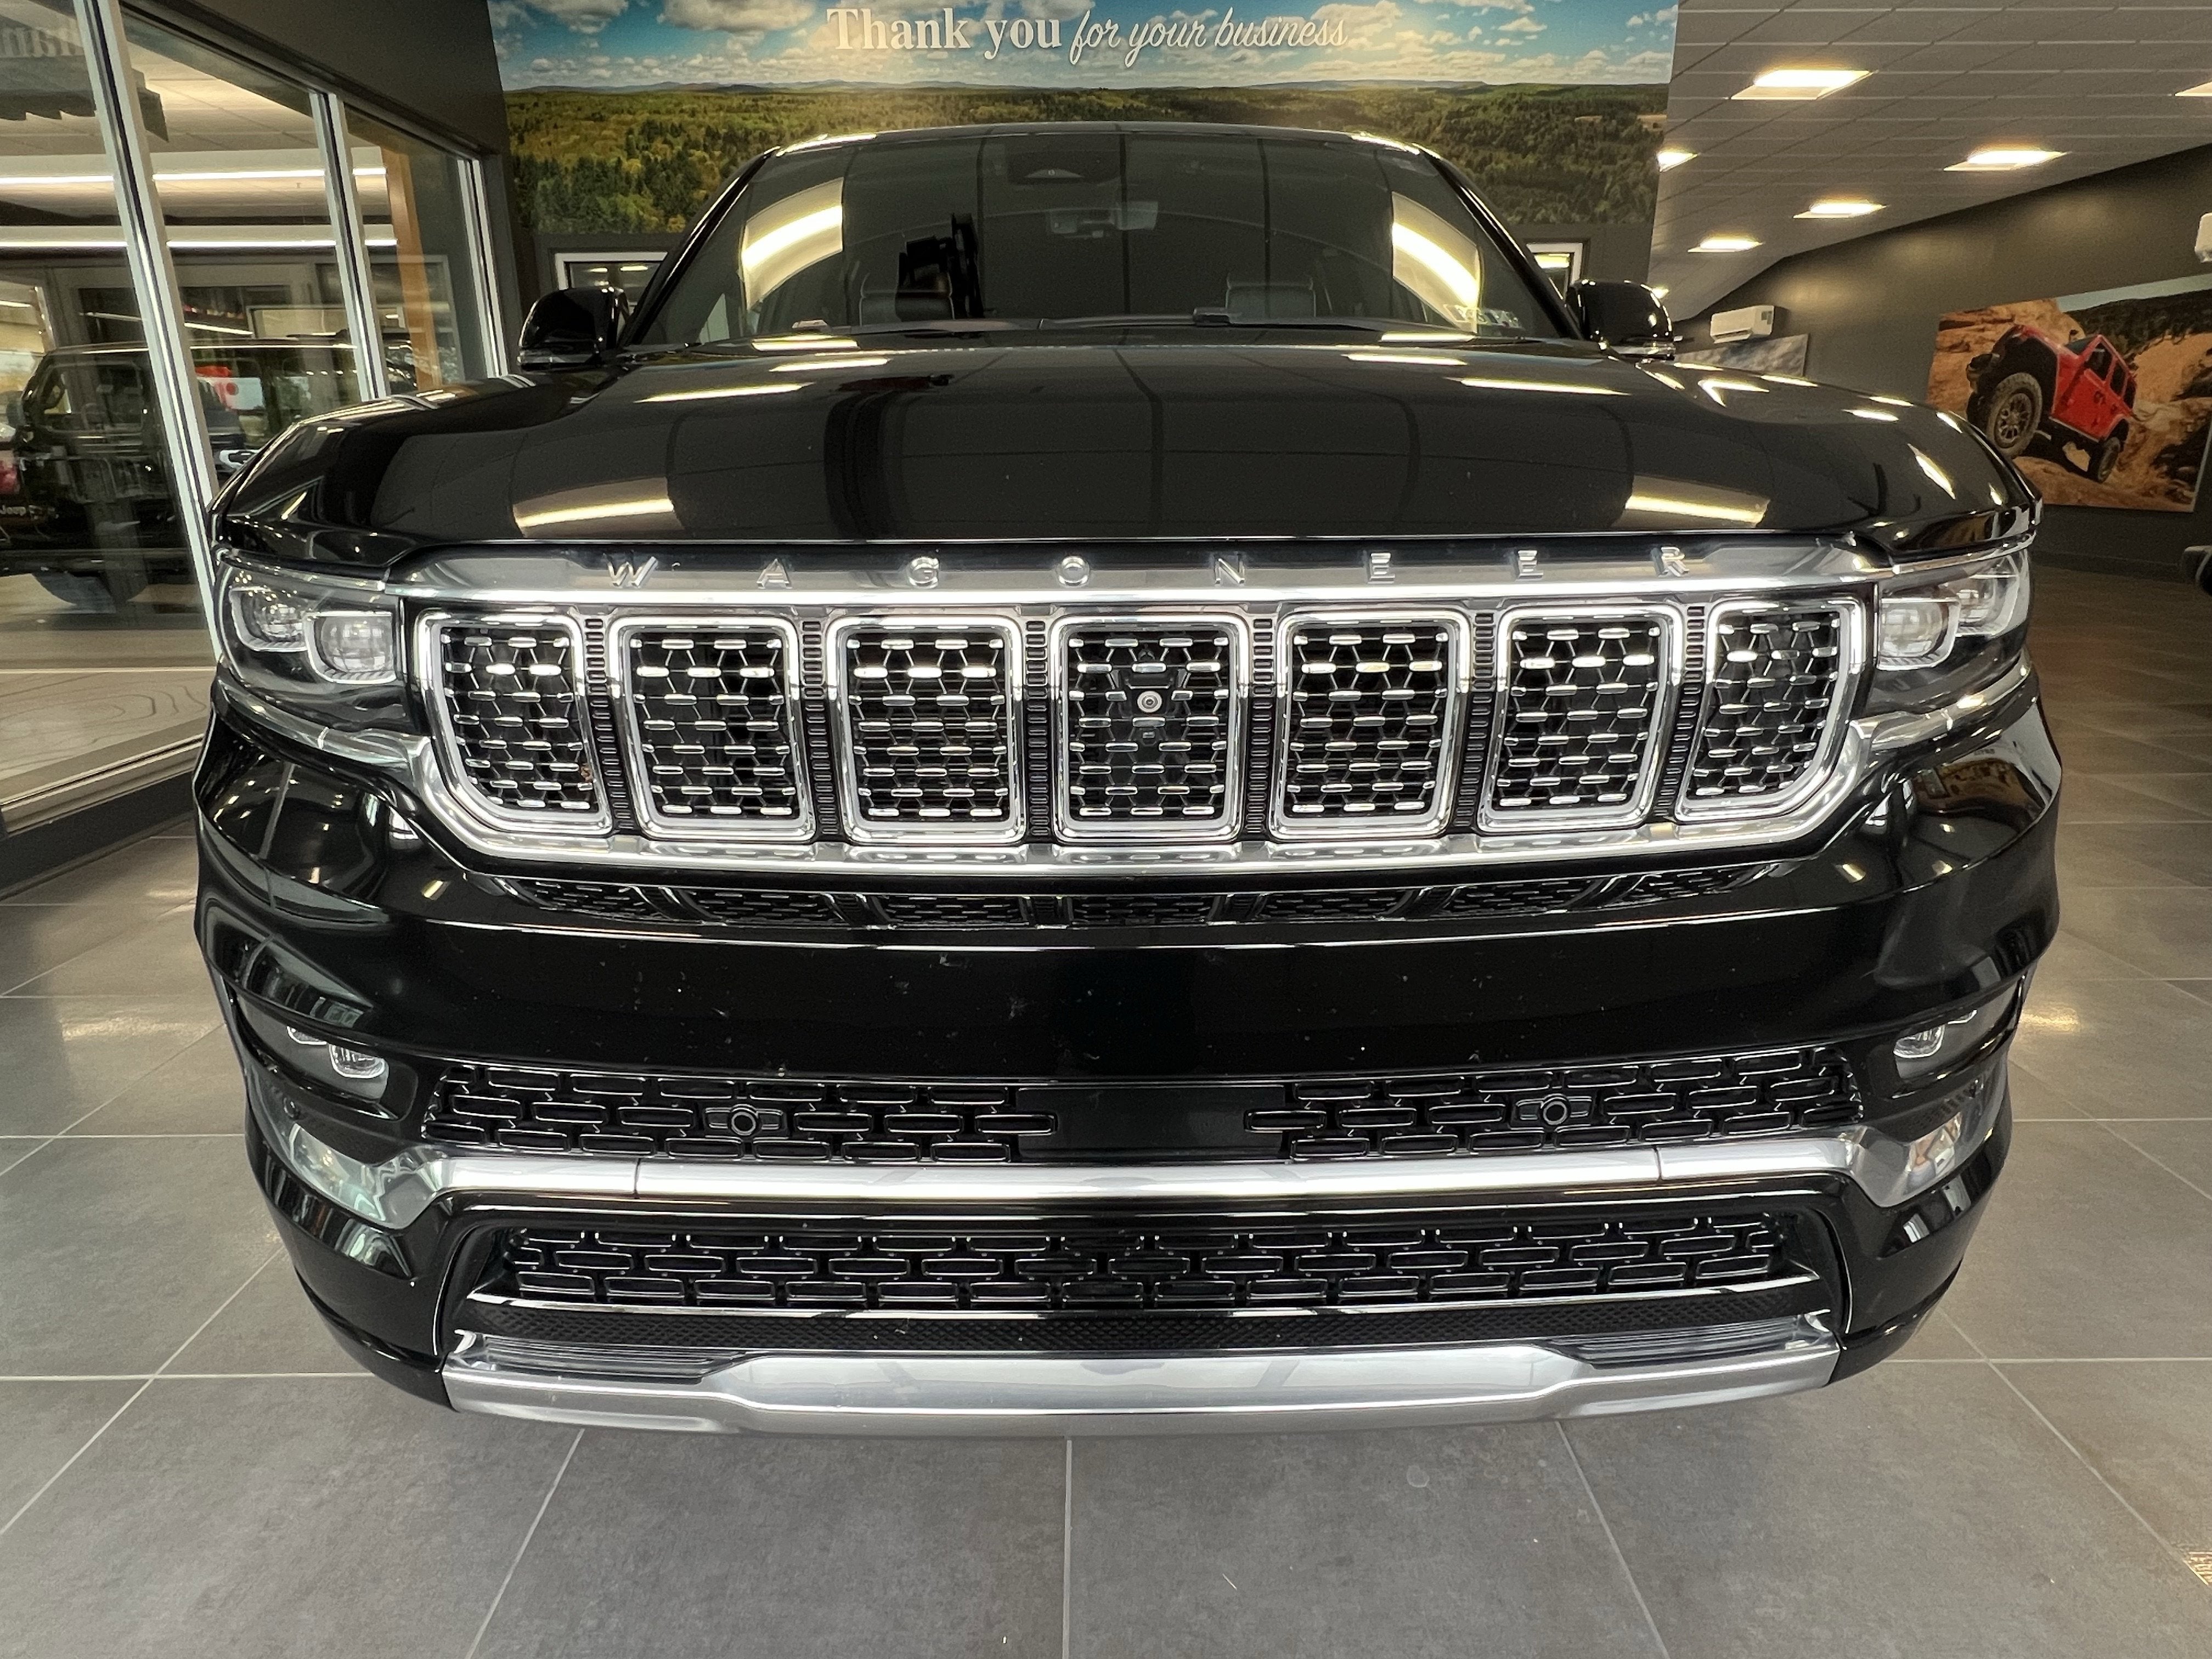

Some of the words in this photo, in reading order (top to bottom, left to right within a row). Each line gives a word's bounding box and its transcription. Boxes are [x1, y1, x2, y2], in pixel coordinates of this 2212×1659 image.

[826, 8, 972, 50] Thank
[984, 19, 1062, 60] you
[1069, 9, 1121, 65] for
[1124, 19, 1206, 68] your
[1214, 7, 1348, 47] business
[603, 546, 1690, 589] WAGONEER
